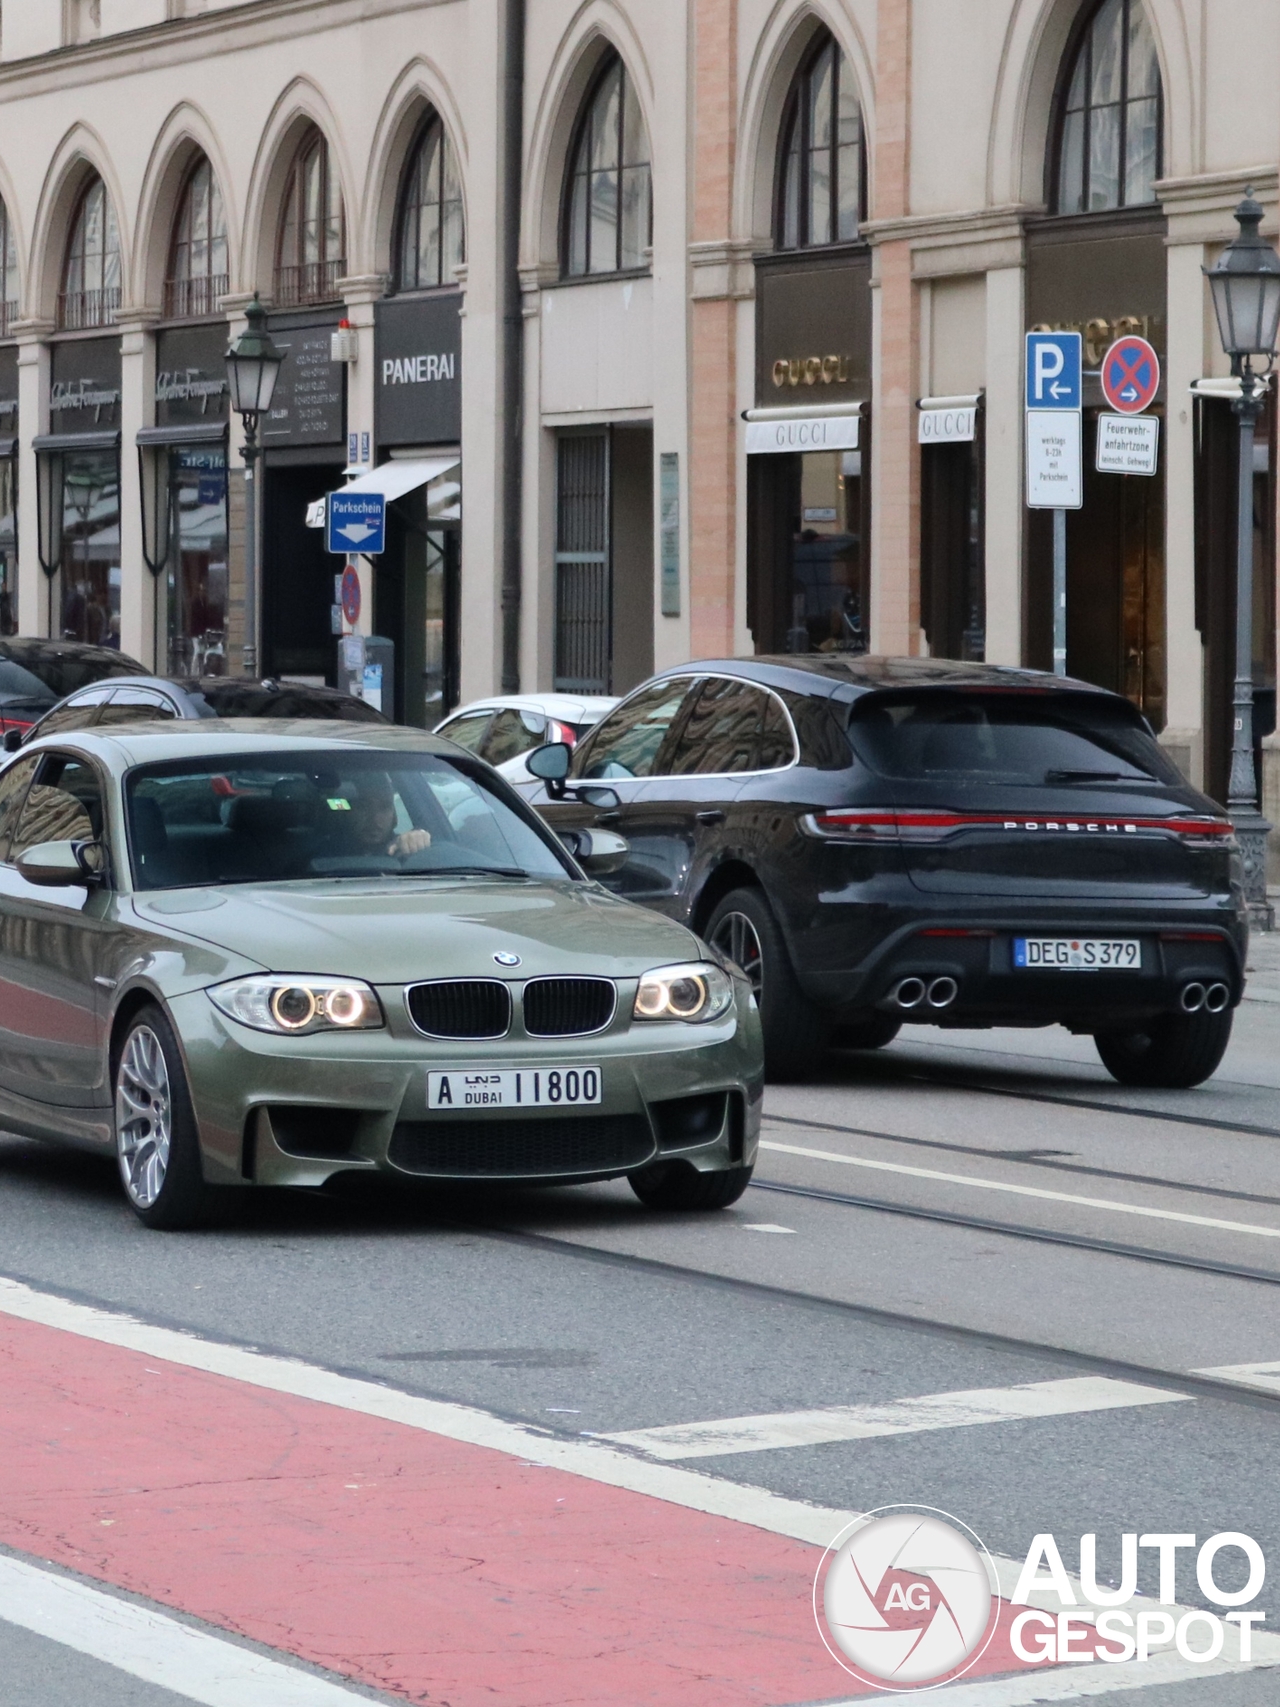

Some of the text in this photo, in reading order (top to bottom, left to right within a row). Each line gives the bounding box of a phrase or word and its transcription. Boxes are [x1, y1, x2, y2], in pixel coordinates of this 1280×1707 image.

[383, 353, 454, 385] PANERAI
[772, 355, 848, 388] GUCCI
[1035, 343, 1064, 399] P
[923, 413, 971, 437] GUCCI
[1107, 422, 1151, 436] Feuerwehr-
[775, 423, 827, 446] GUCCI
[1041, 437, 1066, 447] werktags
[1104, 439, 1150, 452] anfahrtzone
[1039, 472, 1068, 482] Parkschein
[333, 500, 381, 514] Parkschein
[1004, 822, 1137, 832] PORSCHE
[1028, 942, 1137, 965] DEG S 379
[438, 1070, 597, 1104] A 11800
[465, 1092, 502, 1104] DUBAI
